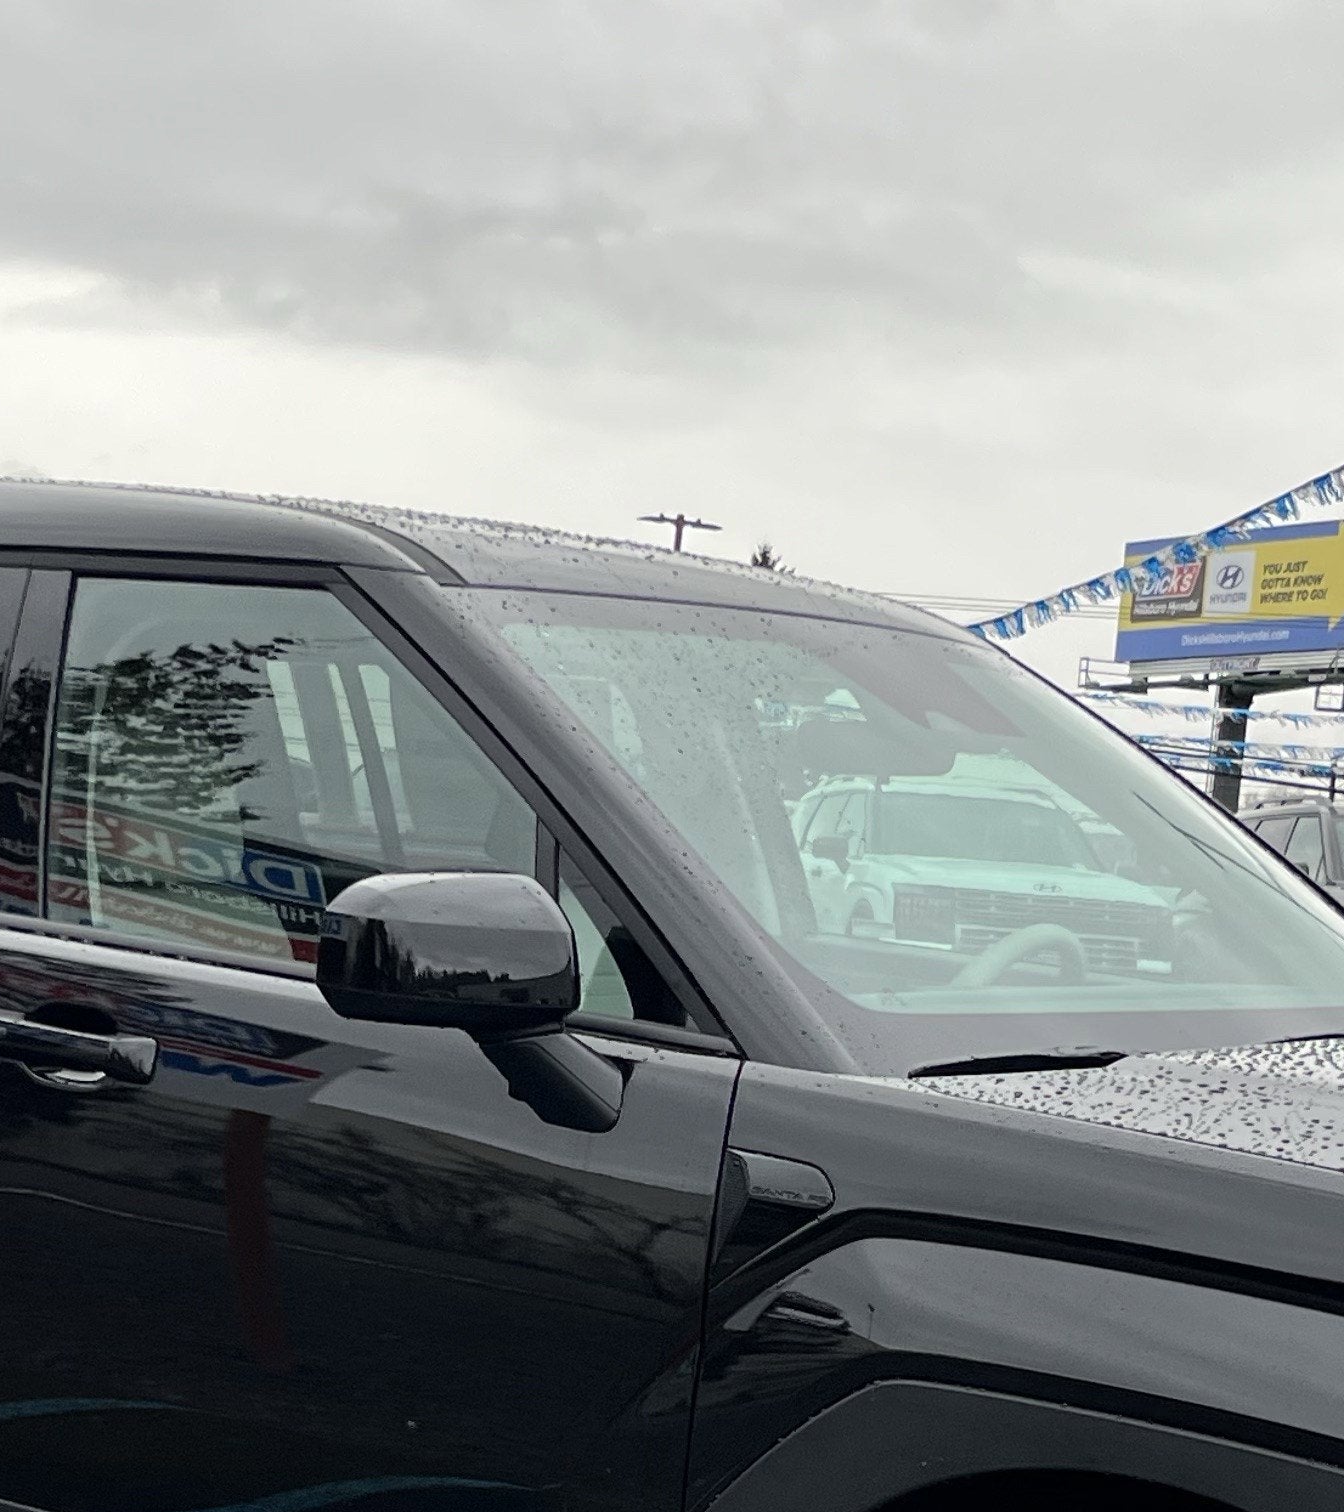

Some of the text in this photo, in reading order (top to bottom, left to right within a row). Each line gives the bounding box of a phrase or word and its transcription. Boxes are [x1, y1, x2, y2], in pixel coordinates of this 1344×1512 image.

[1262, 560, 1308, 575] YOU JUST
[1260, 573, 1325, 590] GOTTA KNOW
[1259, 590, 1294, 604] WHERE
[1296, 590, 1309, 601] TO
